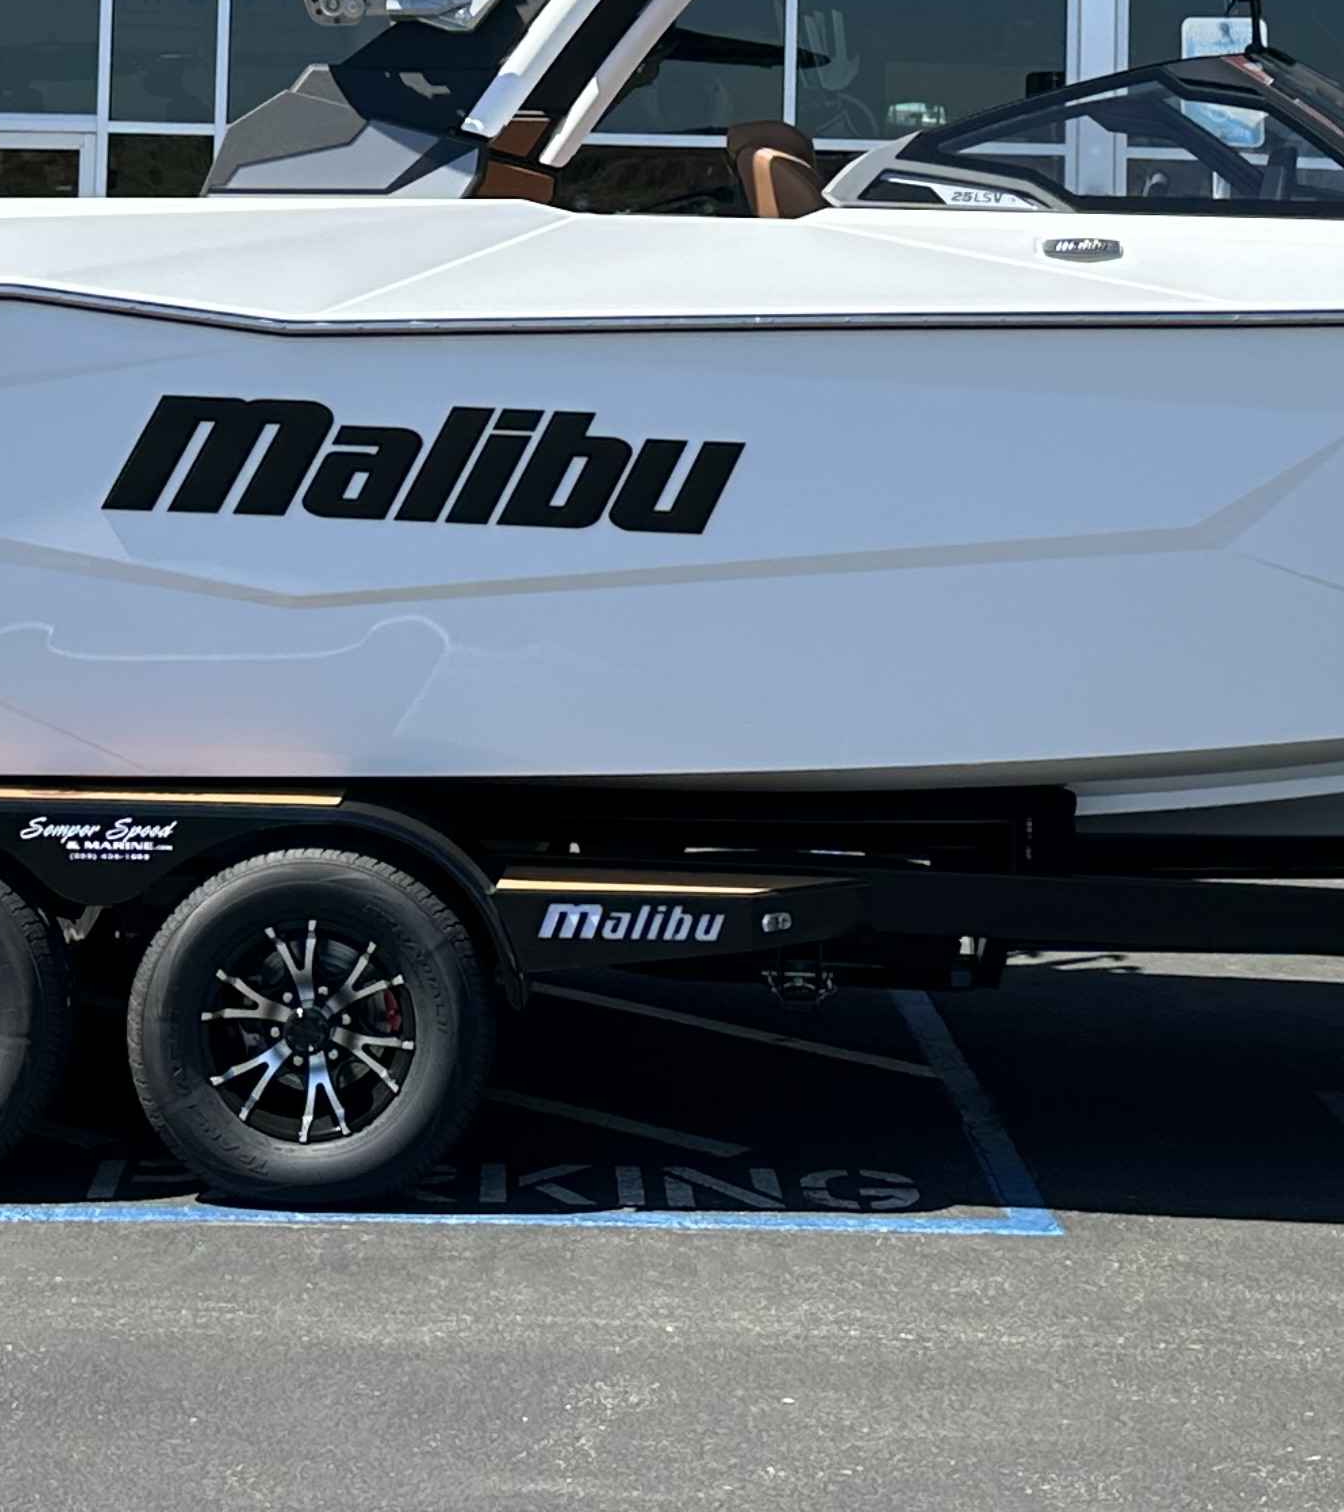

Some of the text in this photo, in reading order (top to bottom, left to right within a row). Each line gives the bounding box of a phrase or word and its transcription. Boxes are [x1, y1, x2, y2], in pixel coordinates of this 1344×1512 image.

[101, 394, 747, 535] Malibu
[20, 816, 178, 844] Semper Speed
[537, 903, 725, 942] Malibu
